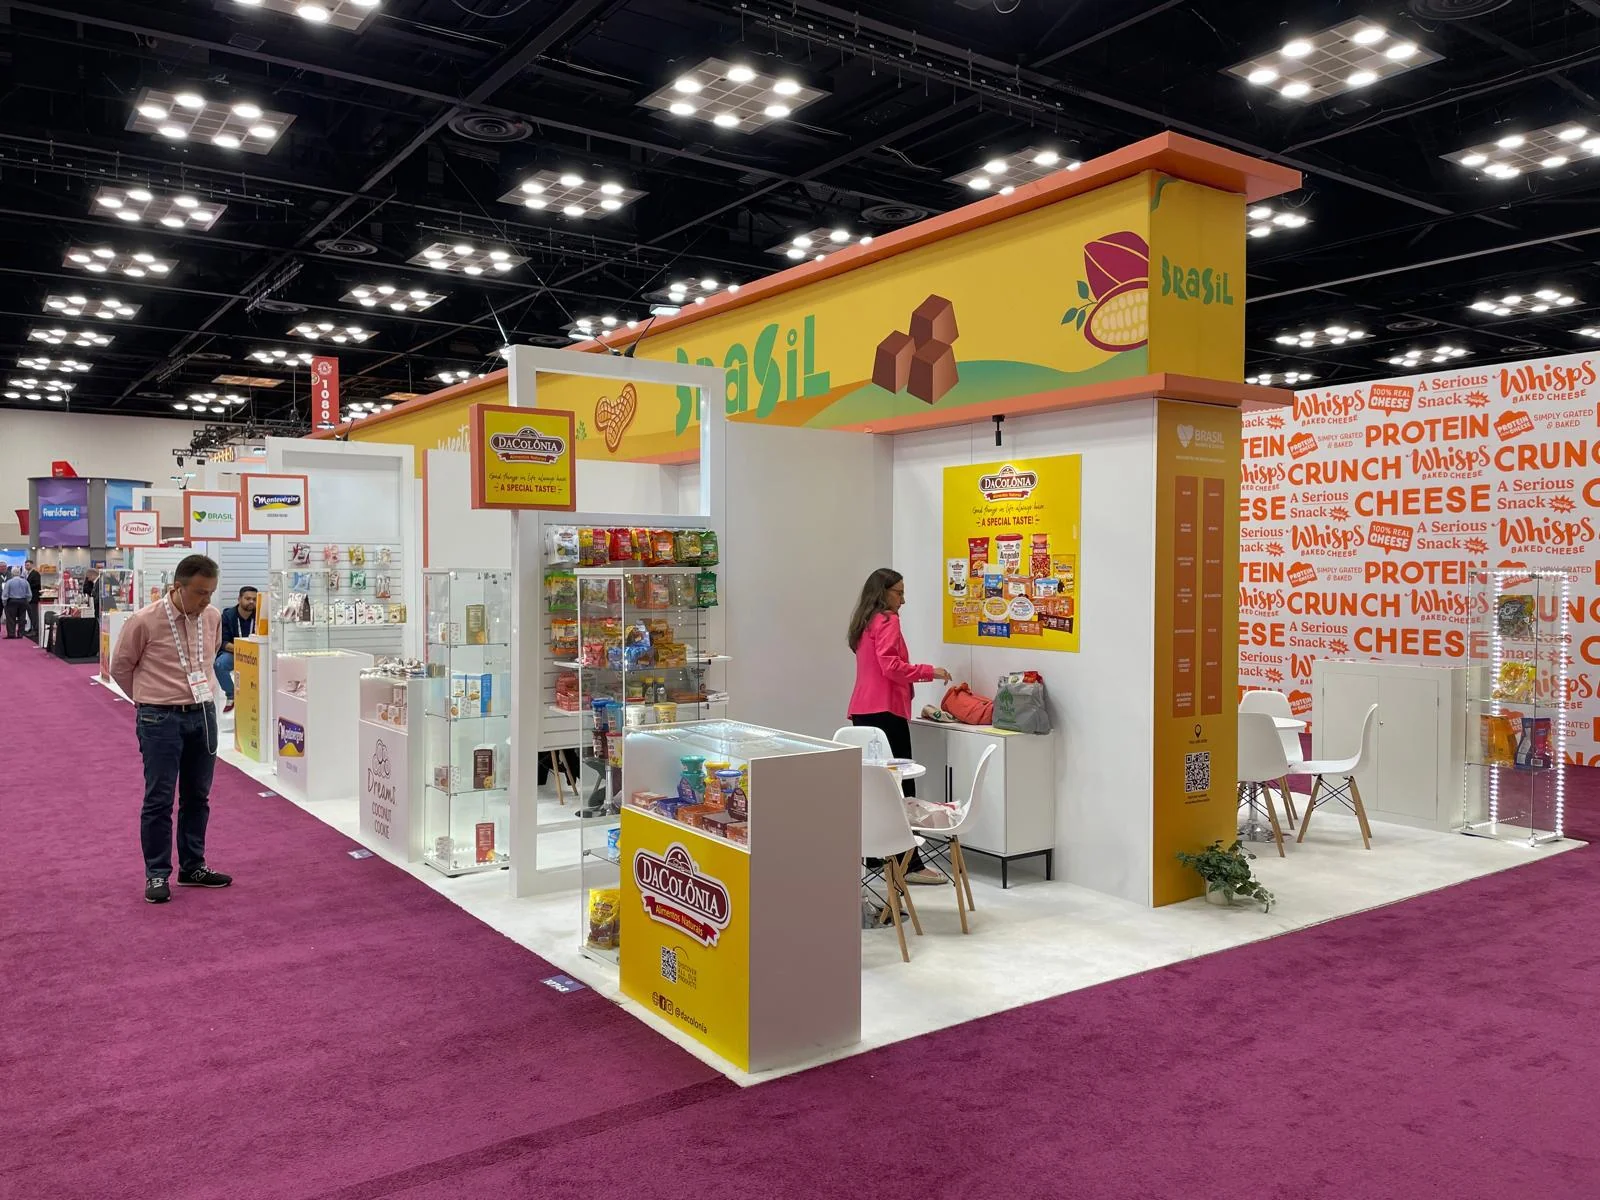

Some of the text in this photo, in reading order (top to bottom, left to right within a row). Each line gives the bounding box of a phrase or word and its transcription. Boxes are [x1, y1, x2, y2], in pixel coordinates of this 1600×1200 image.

[1418, 375, 1488, 392] A Serious
[1493, 360, 1596, 398] Whisps
[1373, 388, 1410, 398] 100% REAL
[1512, 389, 1587, 404] BAKED CHEESE
[1293, 390, 1365, 421] Whisps
[1371, 397, 1409, 409] CHEESE
[1418, 393, 1462, 408] Snack
[1302, 415, 1358, 427] BAKED CHEESE
[1534, 409, 1594, 422] SIMPLY GRATED
[1366, 413, 1489, 448] PROTEIN
[1498, 415, 1529, 434] PROTEIN
[1555, 420, 1581, 429] BAKED
[1194, 429, 1223, 441] BRASIL
[1317, 432, 1364, 443] SIMPLY GRATED
[1334, 440, 1354, 449] BAKED
[1406, 444, 1491, 475] Whisps
[1288, 456, 1401, 486] CRUNCH
[1422, 470, 1483, 481] BAKED CHEESE
[500, 483, 557, 493] A SPECIAL TASTE!
[1255, 484, 1280, 492] CHEESE
[1497, 478, 1574, 492] A Serious
[1290, 491, 1349, 503] A Serious
[1355, 484, 1491, 517] CHEESE
[1497, 496, 1545, 510] Snack
[207, 512, 234, 521] BRASIL
[1290, 506, 1327, 519] Snack
[981, 516, 1034, 527] A SPECIAL TASTE!
[1417, 520, 1487, 533] A Serious
[1241, 527, 1283, 537] Serious
[1290, 525, 1365, 550] Whisps
[1372, 525, 1410, 538] 100% REAL
[1491, 517, 1595, 547] Whisps
[1370, 535, 1409, 549] CHEESE
[1417, 537, 1461, 550] Snack
[1300, 549, 1357, 558] BAKED CHEESE
[1511, 545, 1585, 555] BAKED CHEESE
[1338, 566, 1363, 574] GRATED
[1365, 560, 1488, 584] PROTEIN
[1333, 574, 1353, 582] BAKED
[1287, 591, 1400, 618] CRUNCH
[1404, 589, 1489, 616] Whisps
[1254, 610, 1279, 618] CHEESE
[1421, 614, 1481, 624] BAKED CHEESE
[1289, 621, 1348, 634] A Serious
[1289, 636, 1327, 649] Snack
[1354, 626, 1489, 659] CHEESE
[1240, 651, 1283, 664] Serious
[371, 801, 392, 825] COCONUT
[374, 820, 390, 840] COOKIE
[655, 904, 704, 937] Alimentos Naturais
[674, 1007, 708, 1034] @dacolonia
